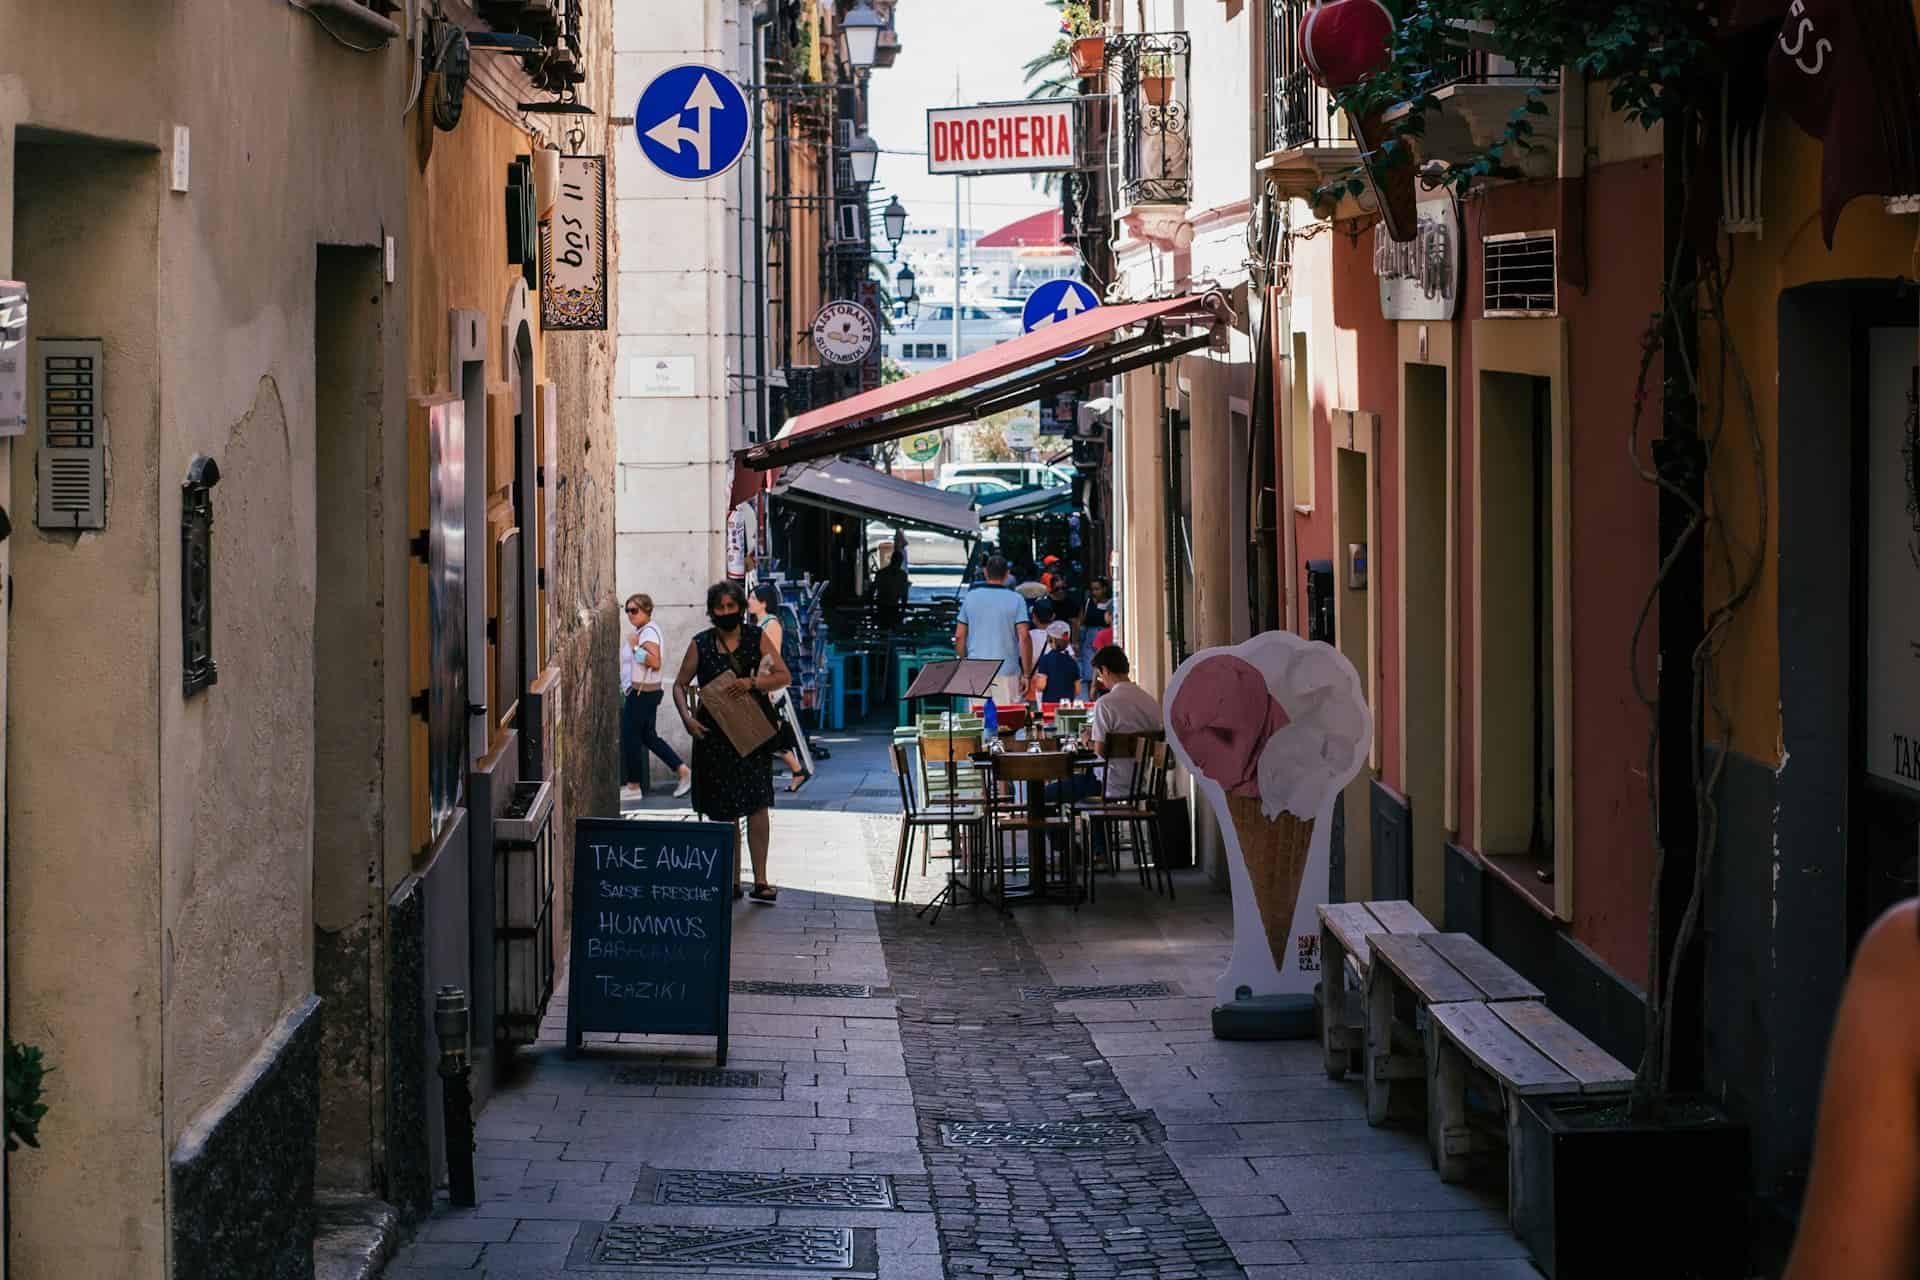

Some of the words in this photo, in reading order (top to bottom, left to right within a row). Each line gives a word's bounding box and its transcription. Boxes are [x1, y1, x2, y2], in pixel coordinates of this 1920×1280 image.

[933, 114, 1071, 163] DROGHERIA
[815, 306, 872, 341] RISTORANTE
[588, 844, 649, 871] TAKE
[656, 844, 718, 879] AWAY
[599, 911, 706, 939] HUMMUS
